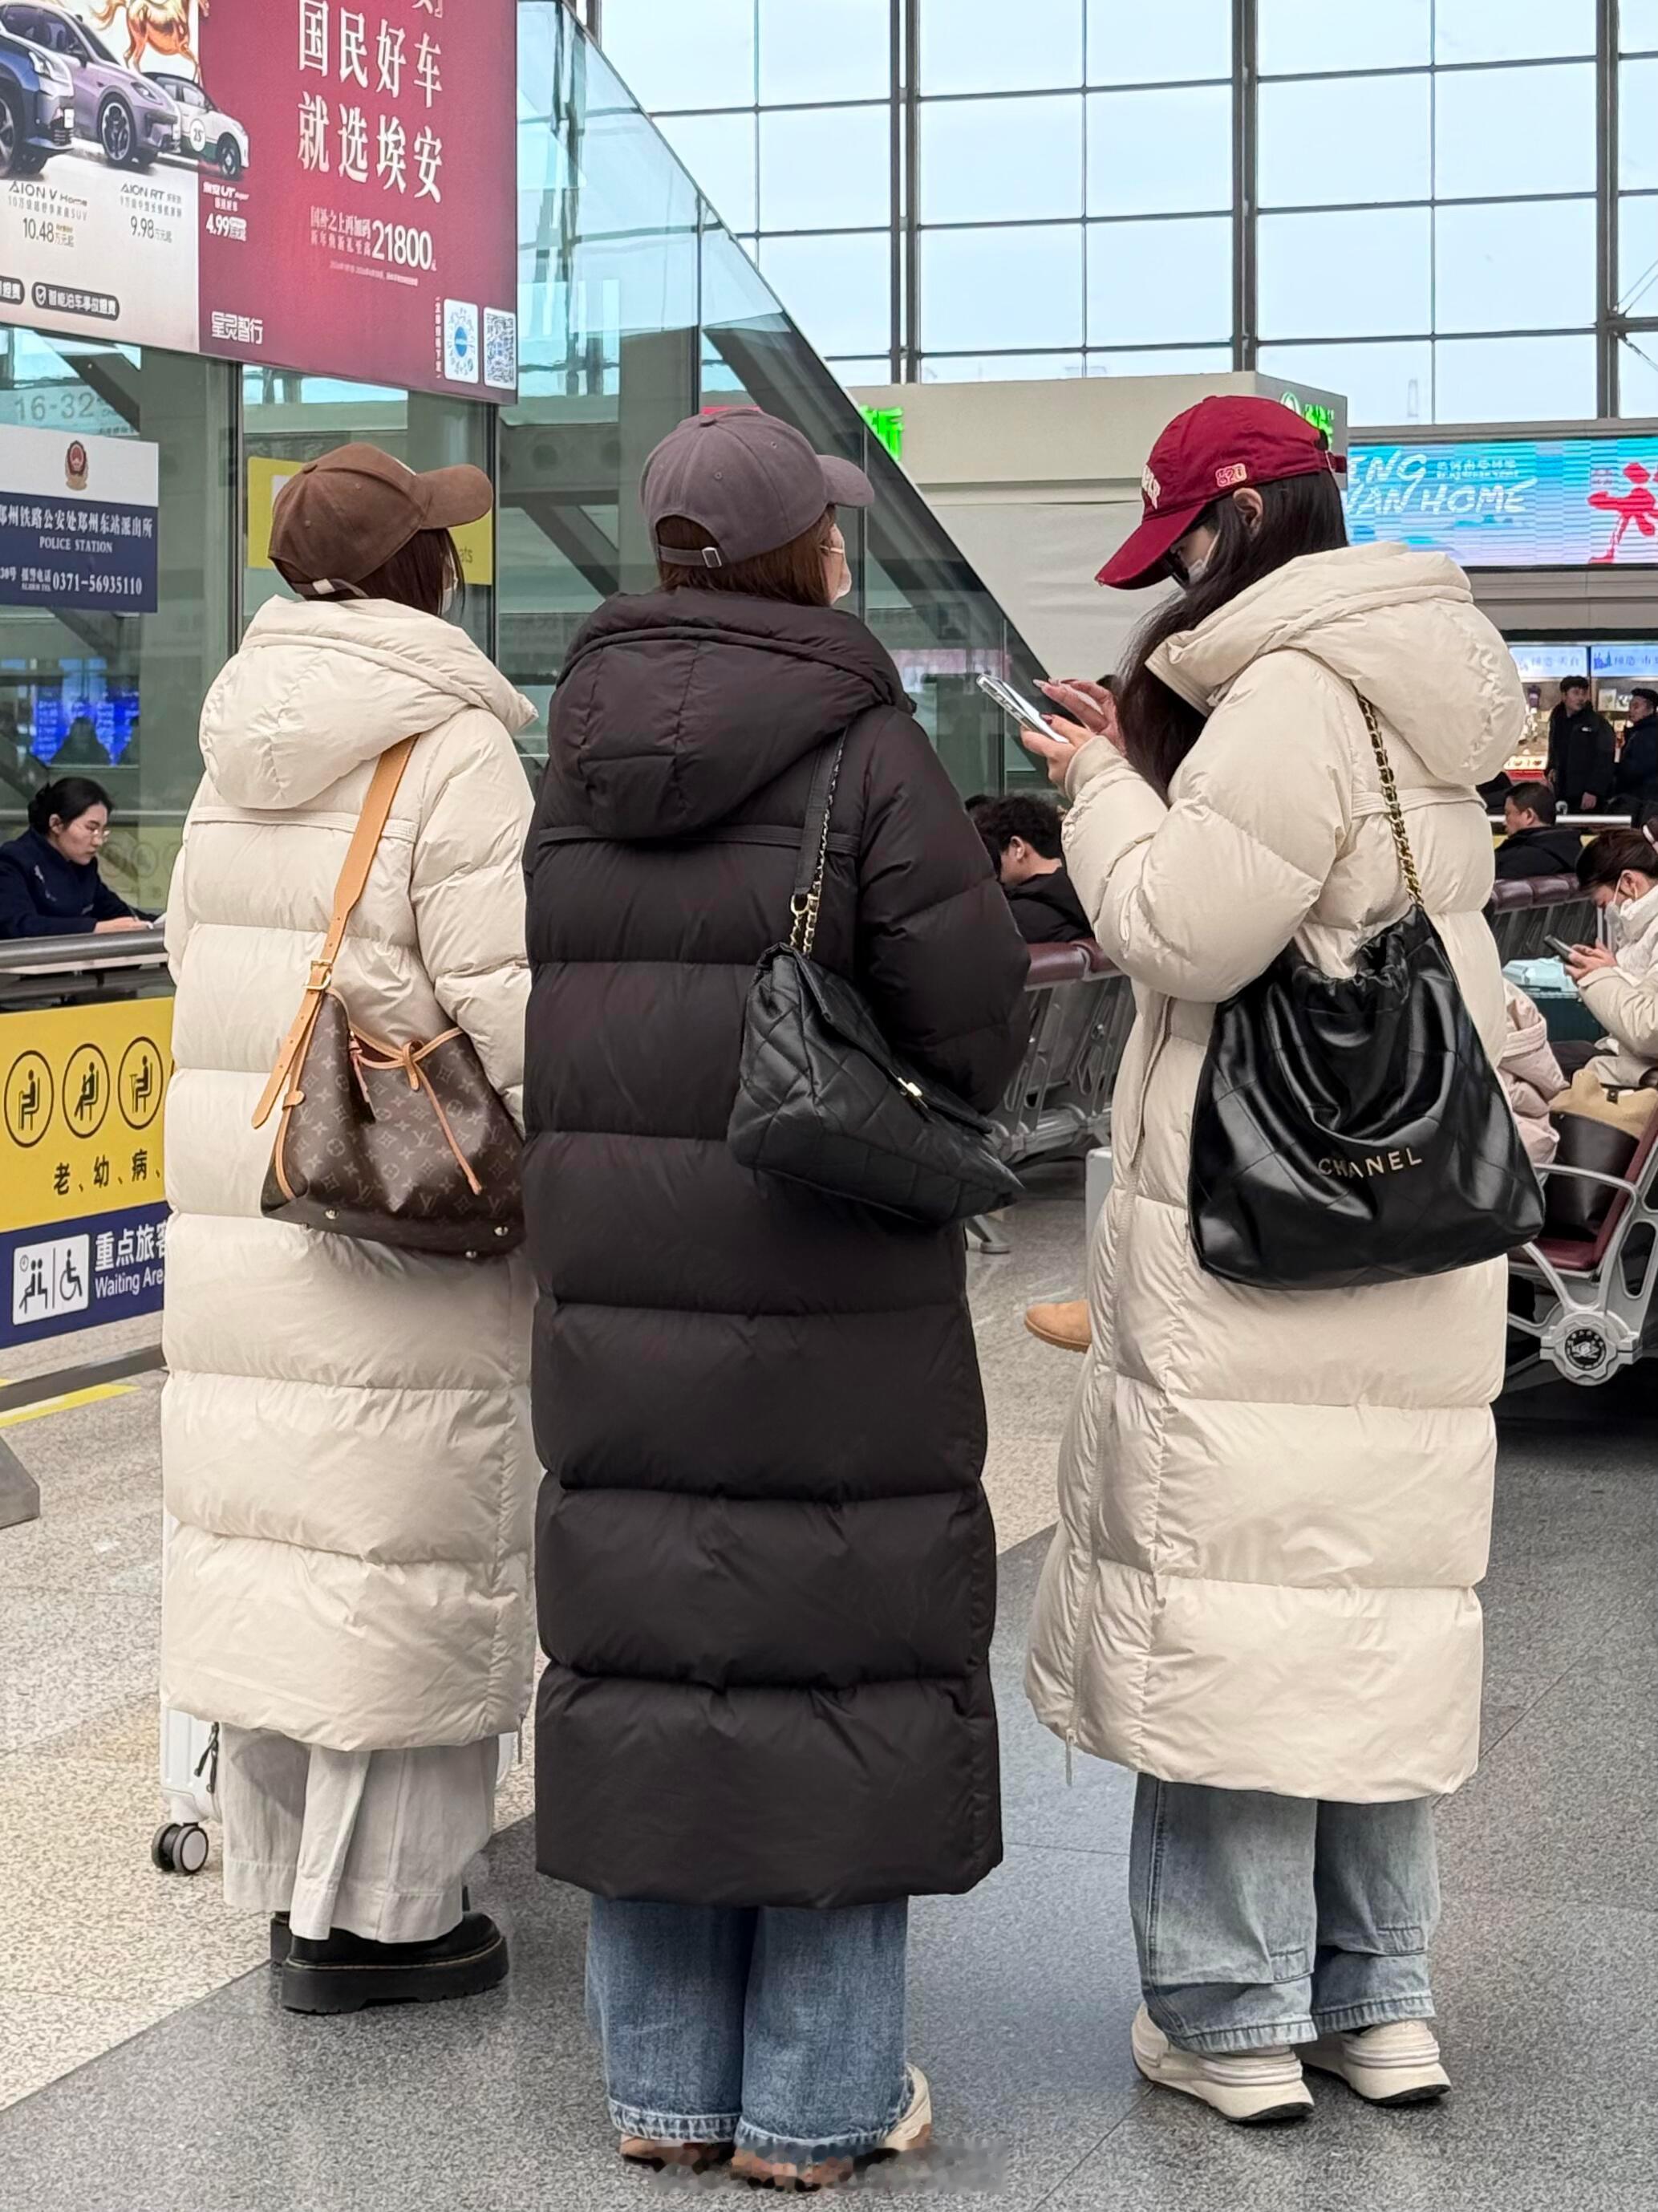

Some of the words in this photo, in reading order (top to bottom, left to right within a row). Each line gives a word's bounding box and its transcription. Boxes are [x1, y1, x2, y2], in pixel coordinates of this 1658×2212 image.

[298, 0, 442, 108] 国民好车
[298, 91, 442, 203] 就选埃安
[9, 181, 45, 199] AION
[22, 217, 55, 243] 10.48
[131, 215, 154, 239] 9.98
[371, 220, 432, 270] 21800
[211, 310, 264, 345] 星灵智行
[1421, 477, 1538, 515] HOME
[39, 536, 71, 551] POLICE
[75, 538, 113, 554] STATION
[52, 571, 143, 595] 0371-56935110
[1318, 1147, 1423, 1179] CHANEL
[95, 1272, 140, 1300] Waiting
